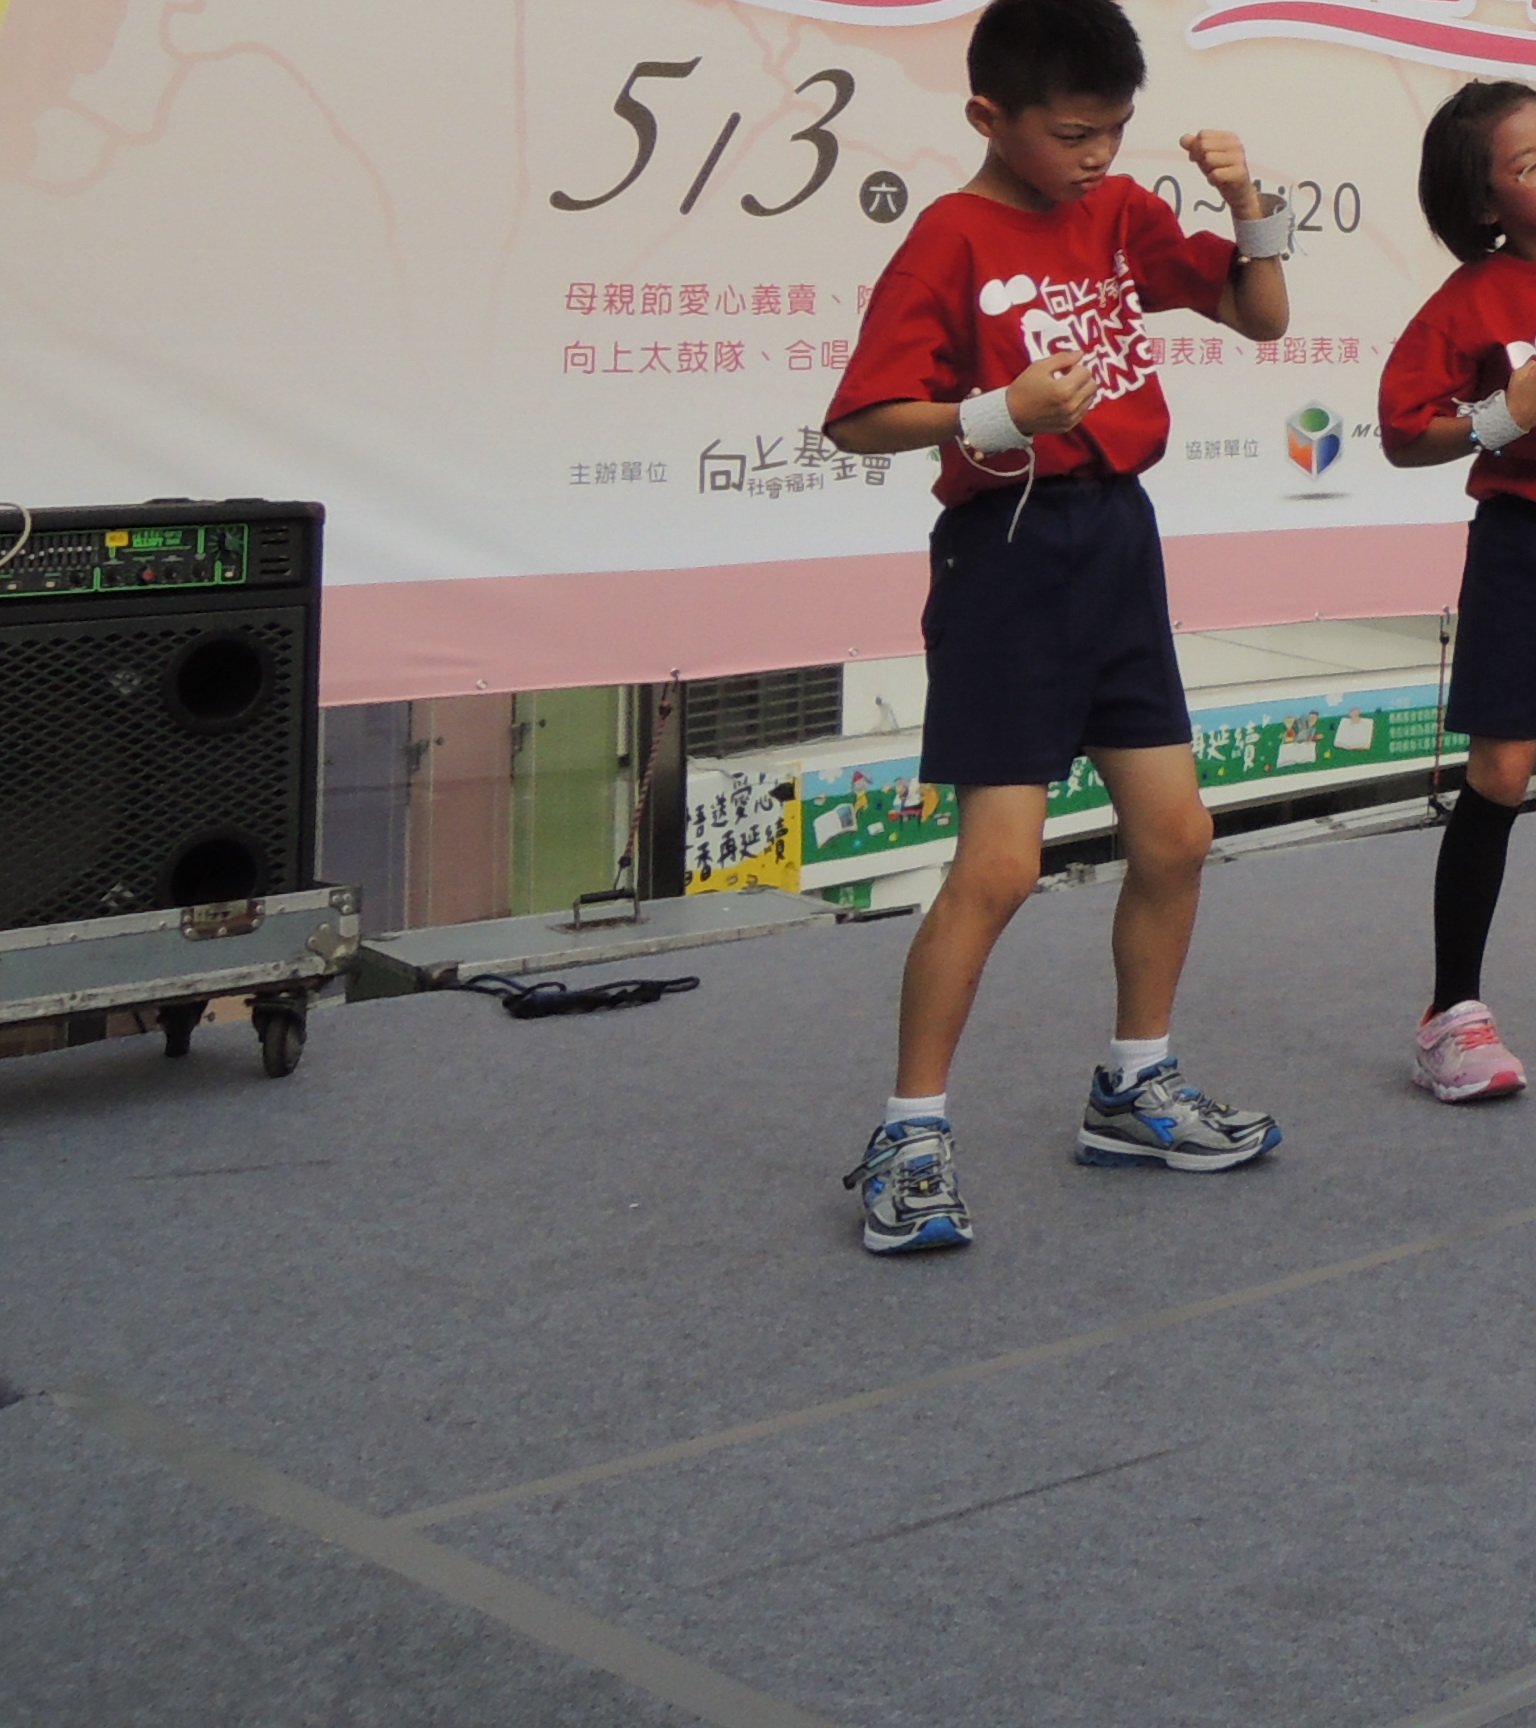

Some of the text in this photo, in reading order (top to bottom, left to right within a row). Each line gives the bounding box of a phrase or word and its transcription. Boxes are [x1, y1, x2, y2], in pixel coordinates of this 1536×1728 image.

[549, 55, 856, 218] 5/3
[1185, 438, 1260, 461] 協辦單位
[569, 461, 669, 486] 主辦單位
[746, 471, 825, 500] 社會福利
